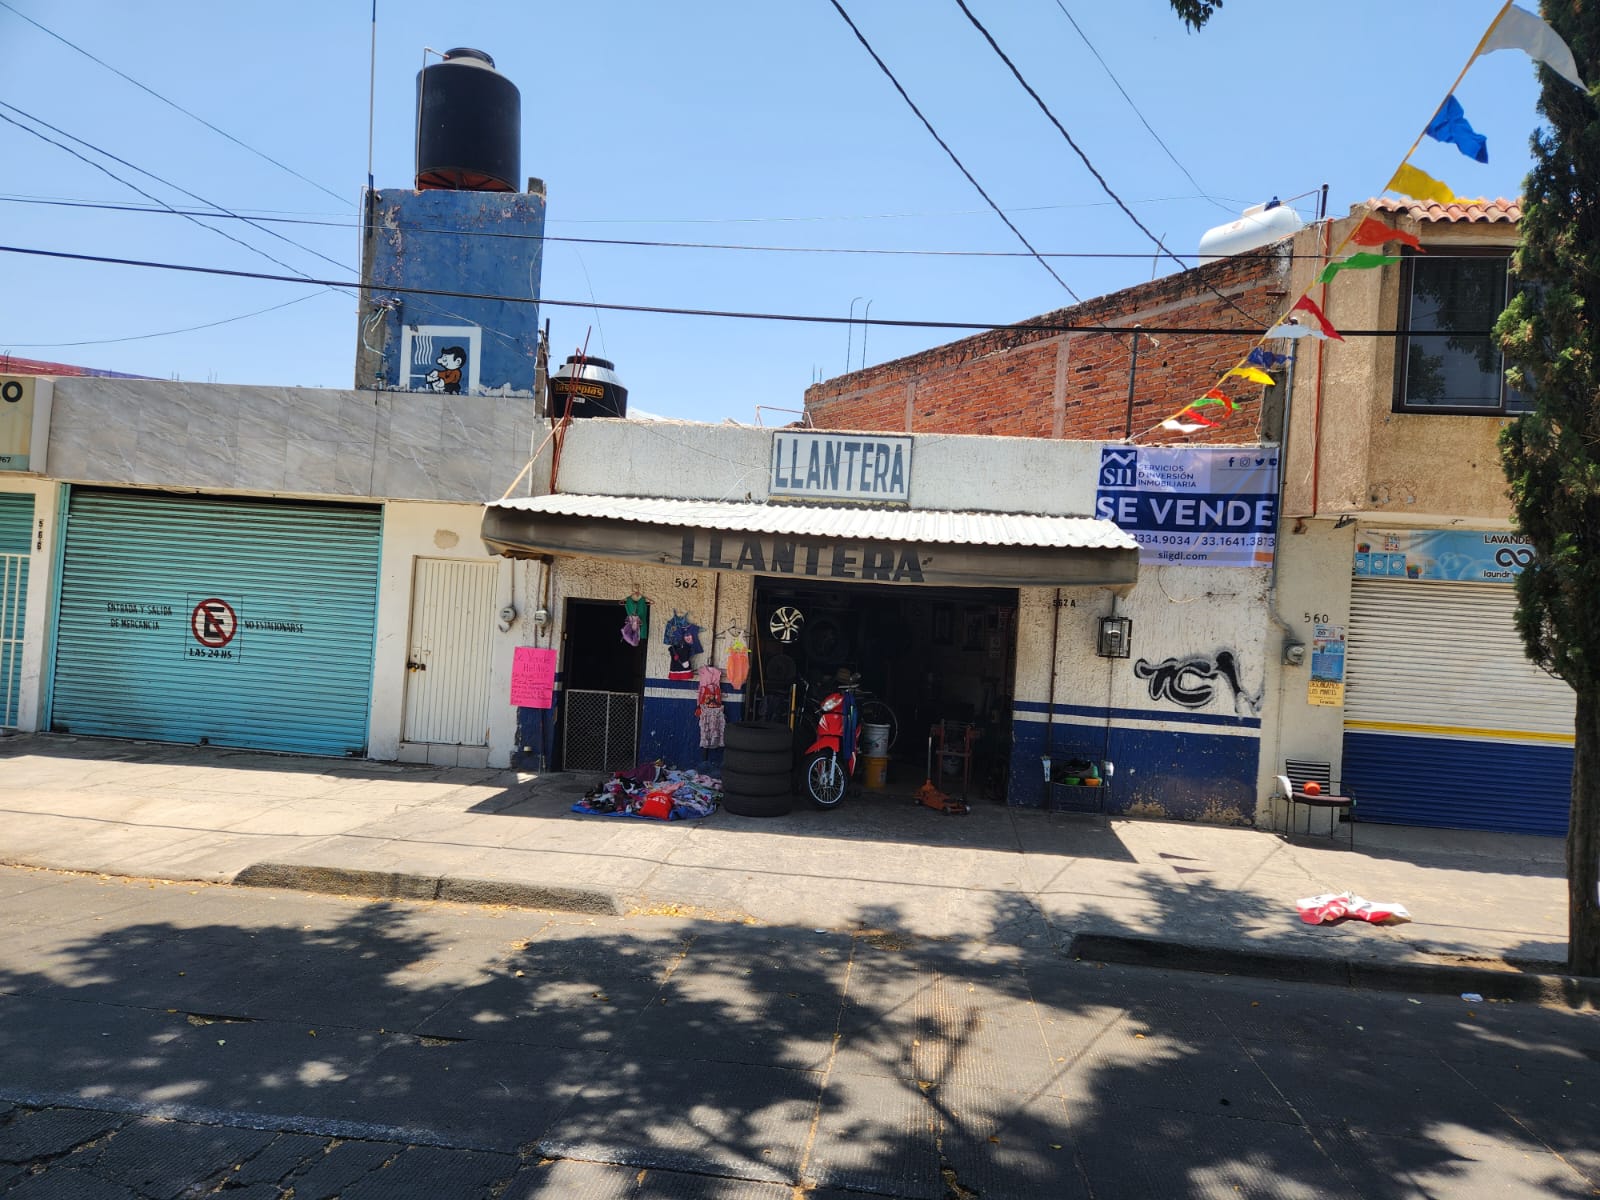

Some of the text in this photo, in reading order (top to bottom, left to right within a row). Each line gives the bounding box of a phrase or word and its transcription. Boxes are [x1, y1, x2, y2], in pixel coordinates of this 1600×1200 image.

[0, 381, 23, 403] O
[0, 456, 12, 464] 67
[775, 438, 905, 494] LLANTERA
[1138, 464, 1185, 472] SERVICIOS
[1146, 472, 1194, 480] INVERSIÓN
[1138, 479, 1197, 488] INMOBILIARIA
[1096, 496, 1273, 527] SE VENDE
[1484, 534, 1534, 545] LAVANDE
[681, 534, 925, 583] LLANTERA
[1483, 570, 1515, 578] laundr
[675, 577, 698, 589] 562
[1304, 612, 1329, 624] 560
[190, 647, 232, 659] LAS 24 HS
